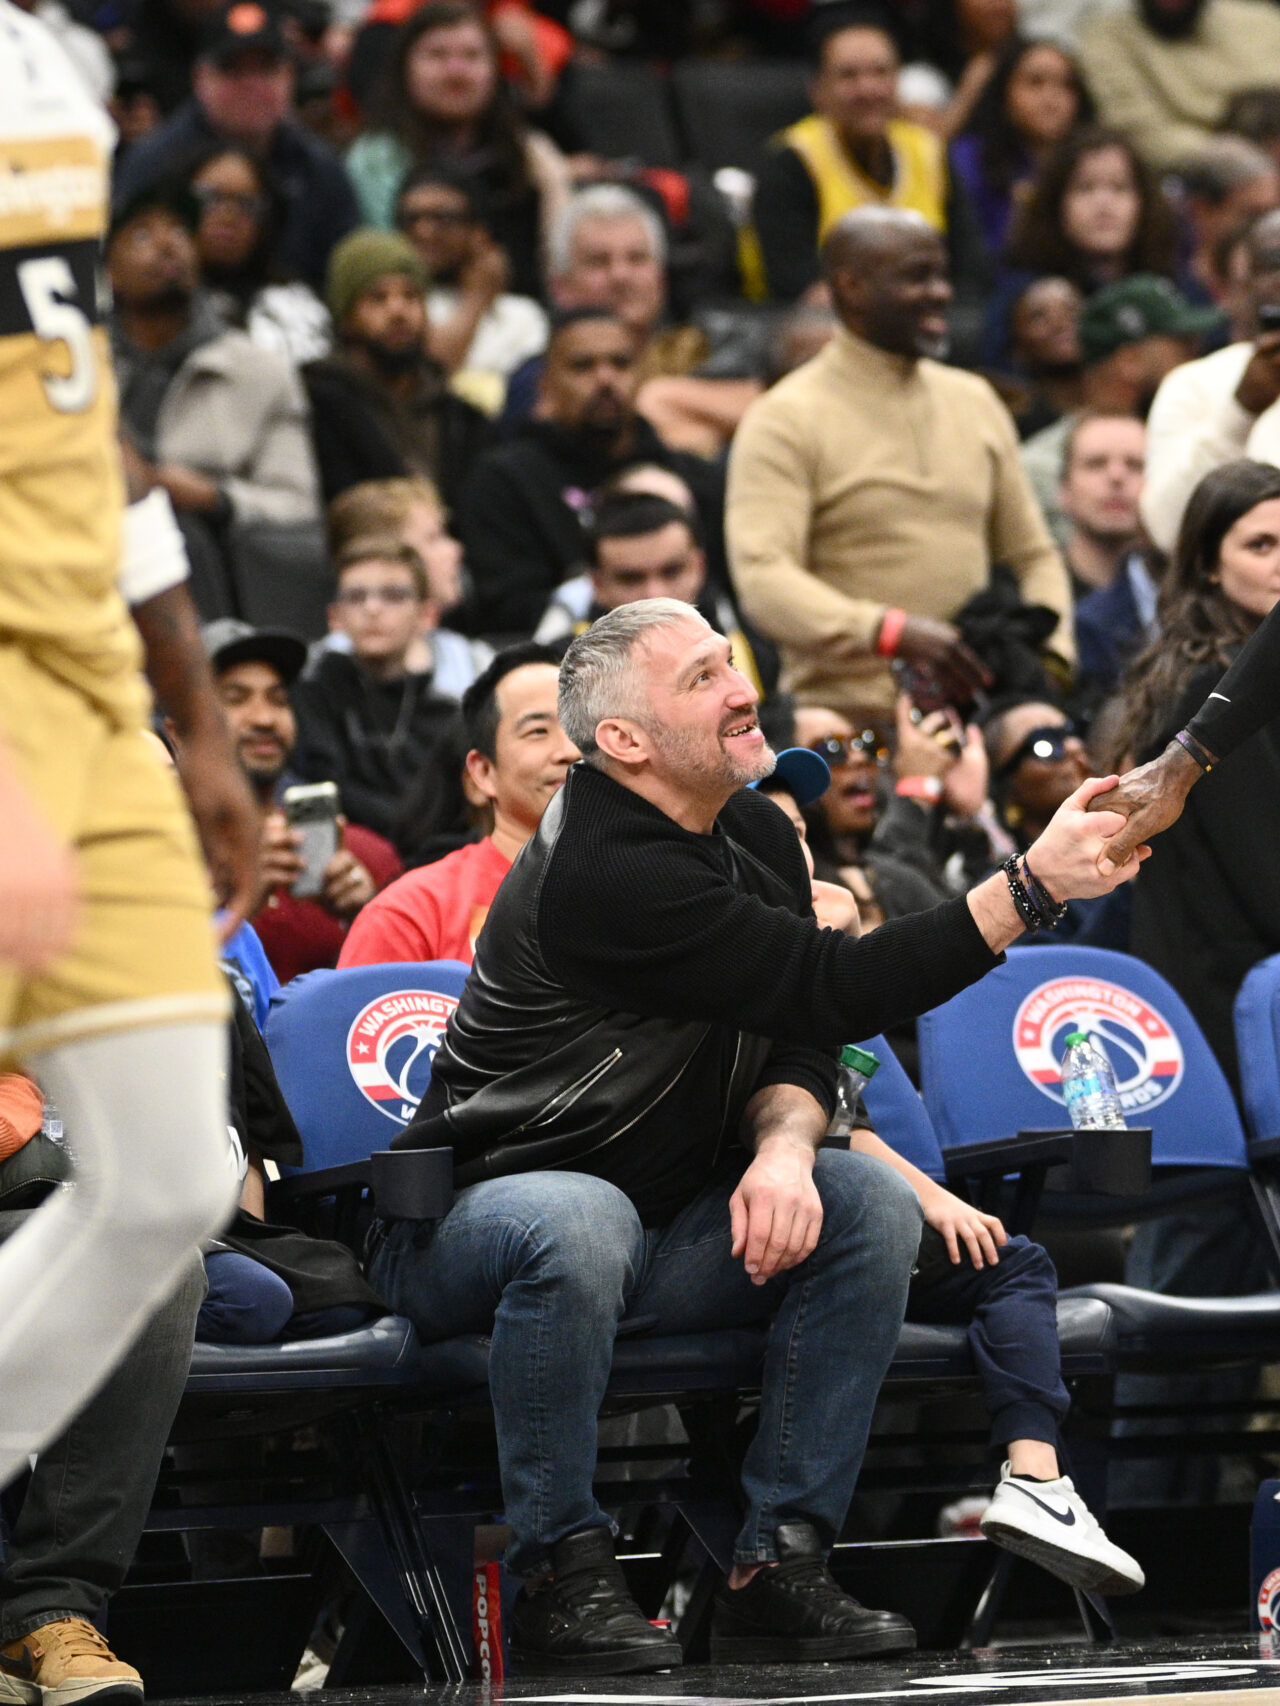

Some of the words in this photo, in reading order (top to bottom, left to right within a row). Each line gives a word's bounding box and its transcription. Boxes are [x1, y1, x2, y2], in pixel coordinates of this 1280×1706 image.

[16, 255, 97, 412] 5
[358, 996, 457, 1037] WASHINGT
[1023, 984, 1142, 1025] WASHINGTON
[476, 1574, 490, 1679] POPCO
